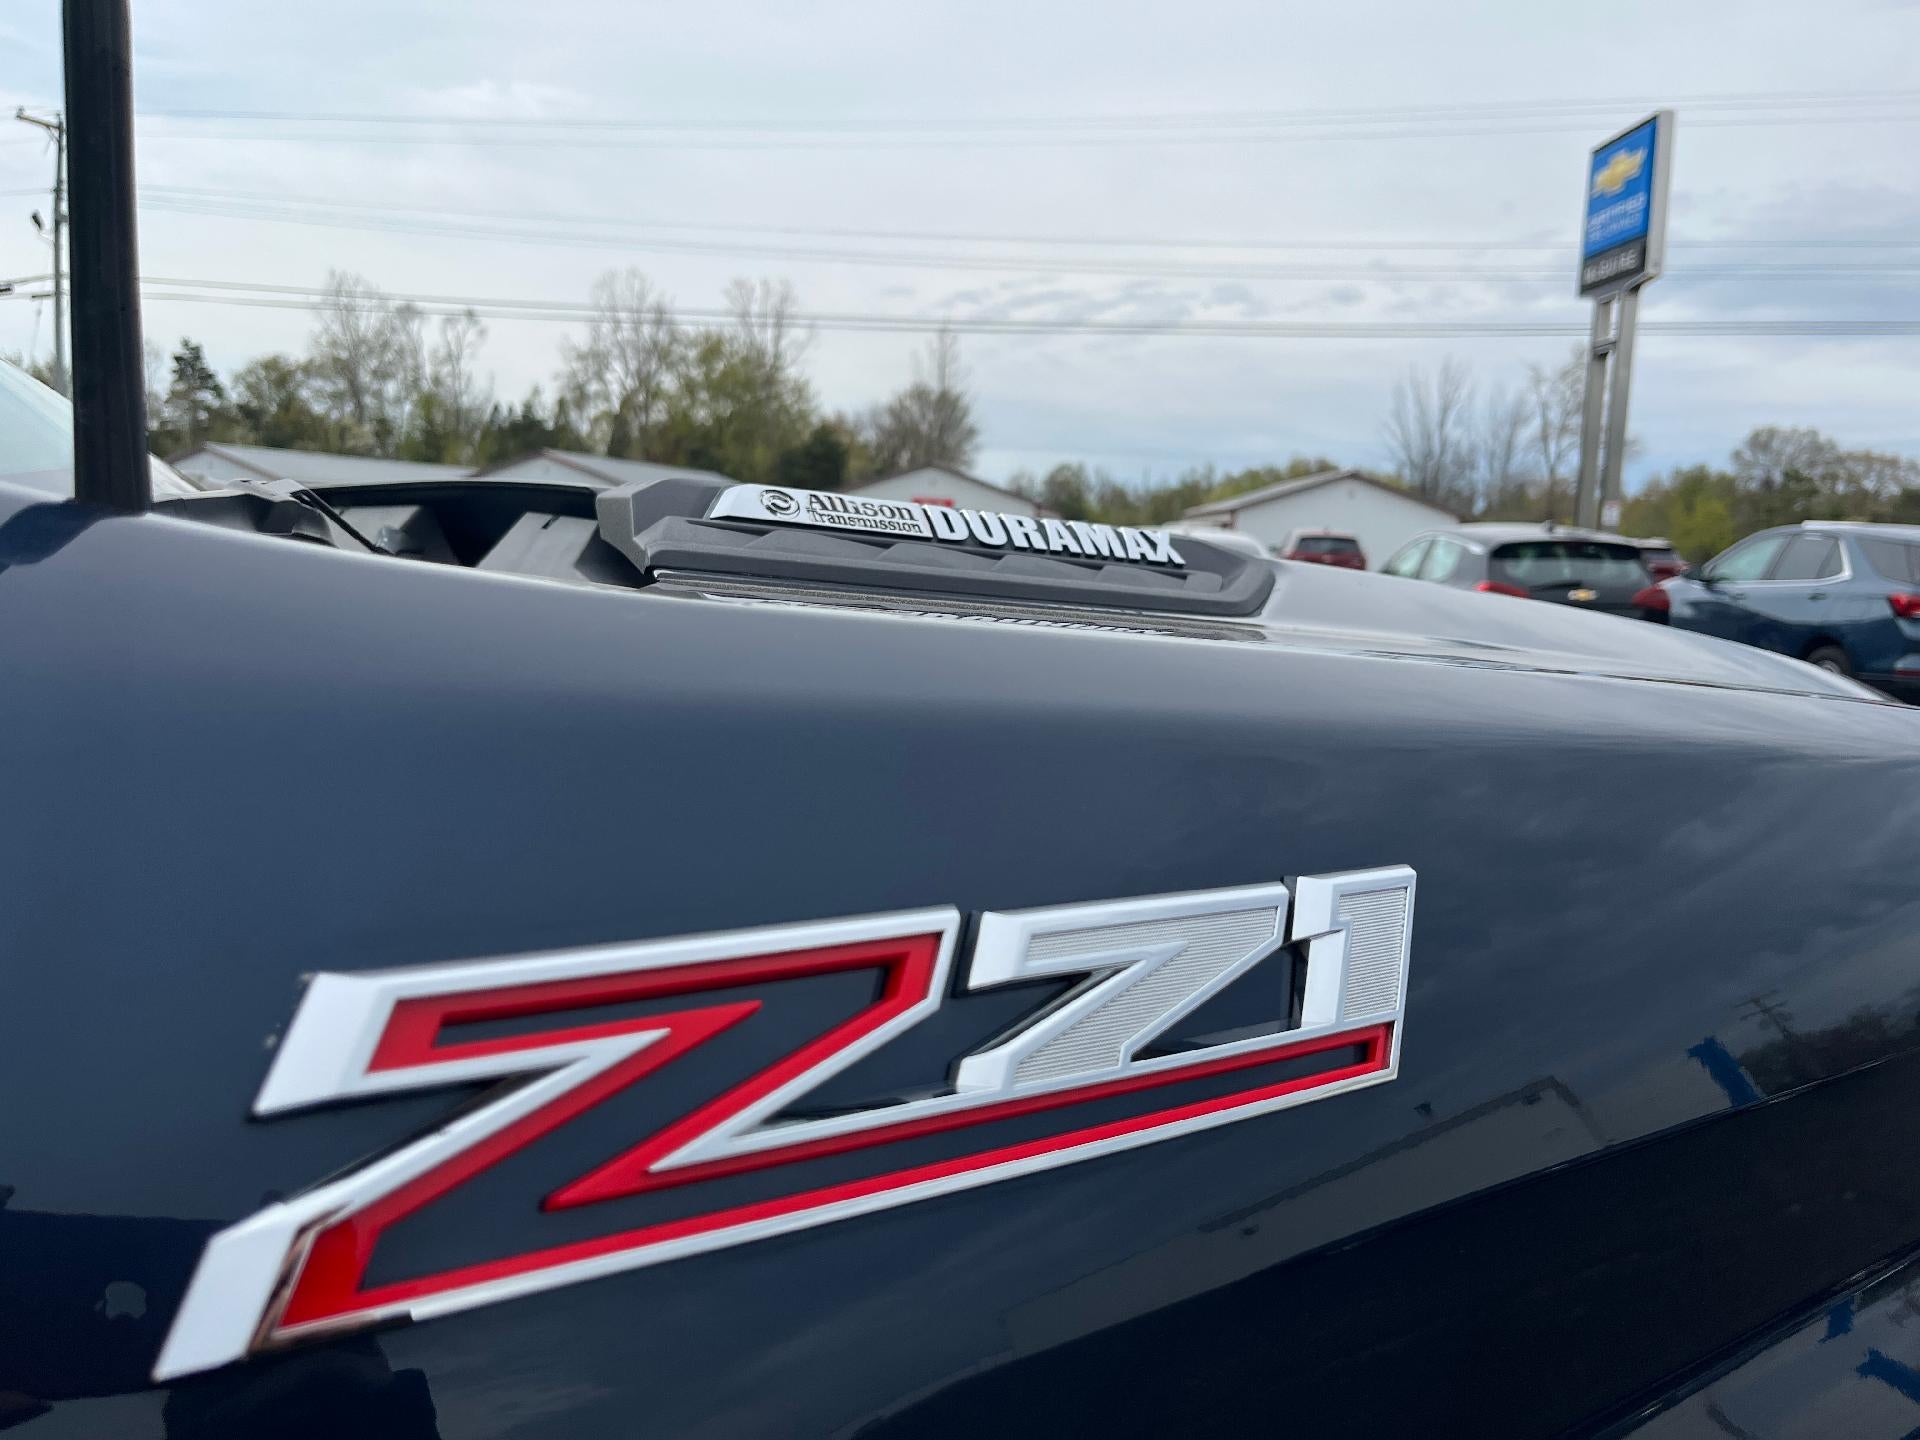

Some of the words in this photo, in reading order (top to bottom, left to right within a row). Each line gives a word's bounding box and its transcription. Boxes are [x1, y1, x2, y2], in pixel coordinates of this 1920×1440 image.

[806, 506, 924, 534] Transmission
[807, 493, 919, 521] Allison
[922, 504, 1186, 565] DURAMAX
[154, 864, 1417, 1382] Z71
